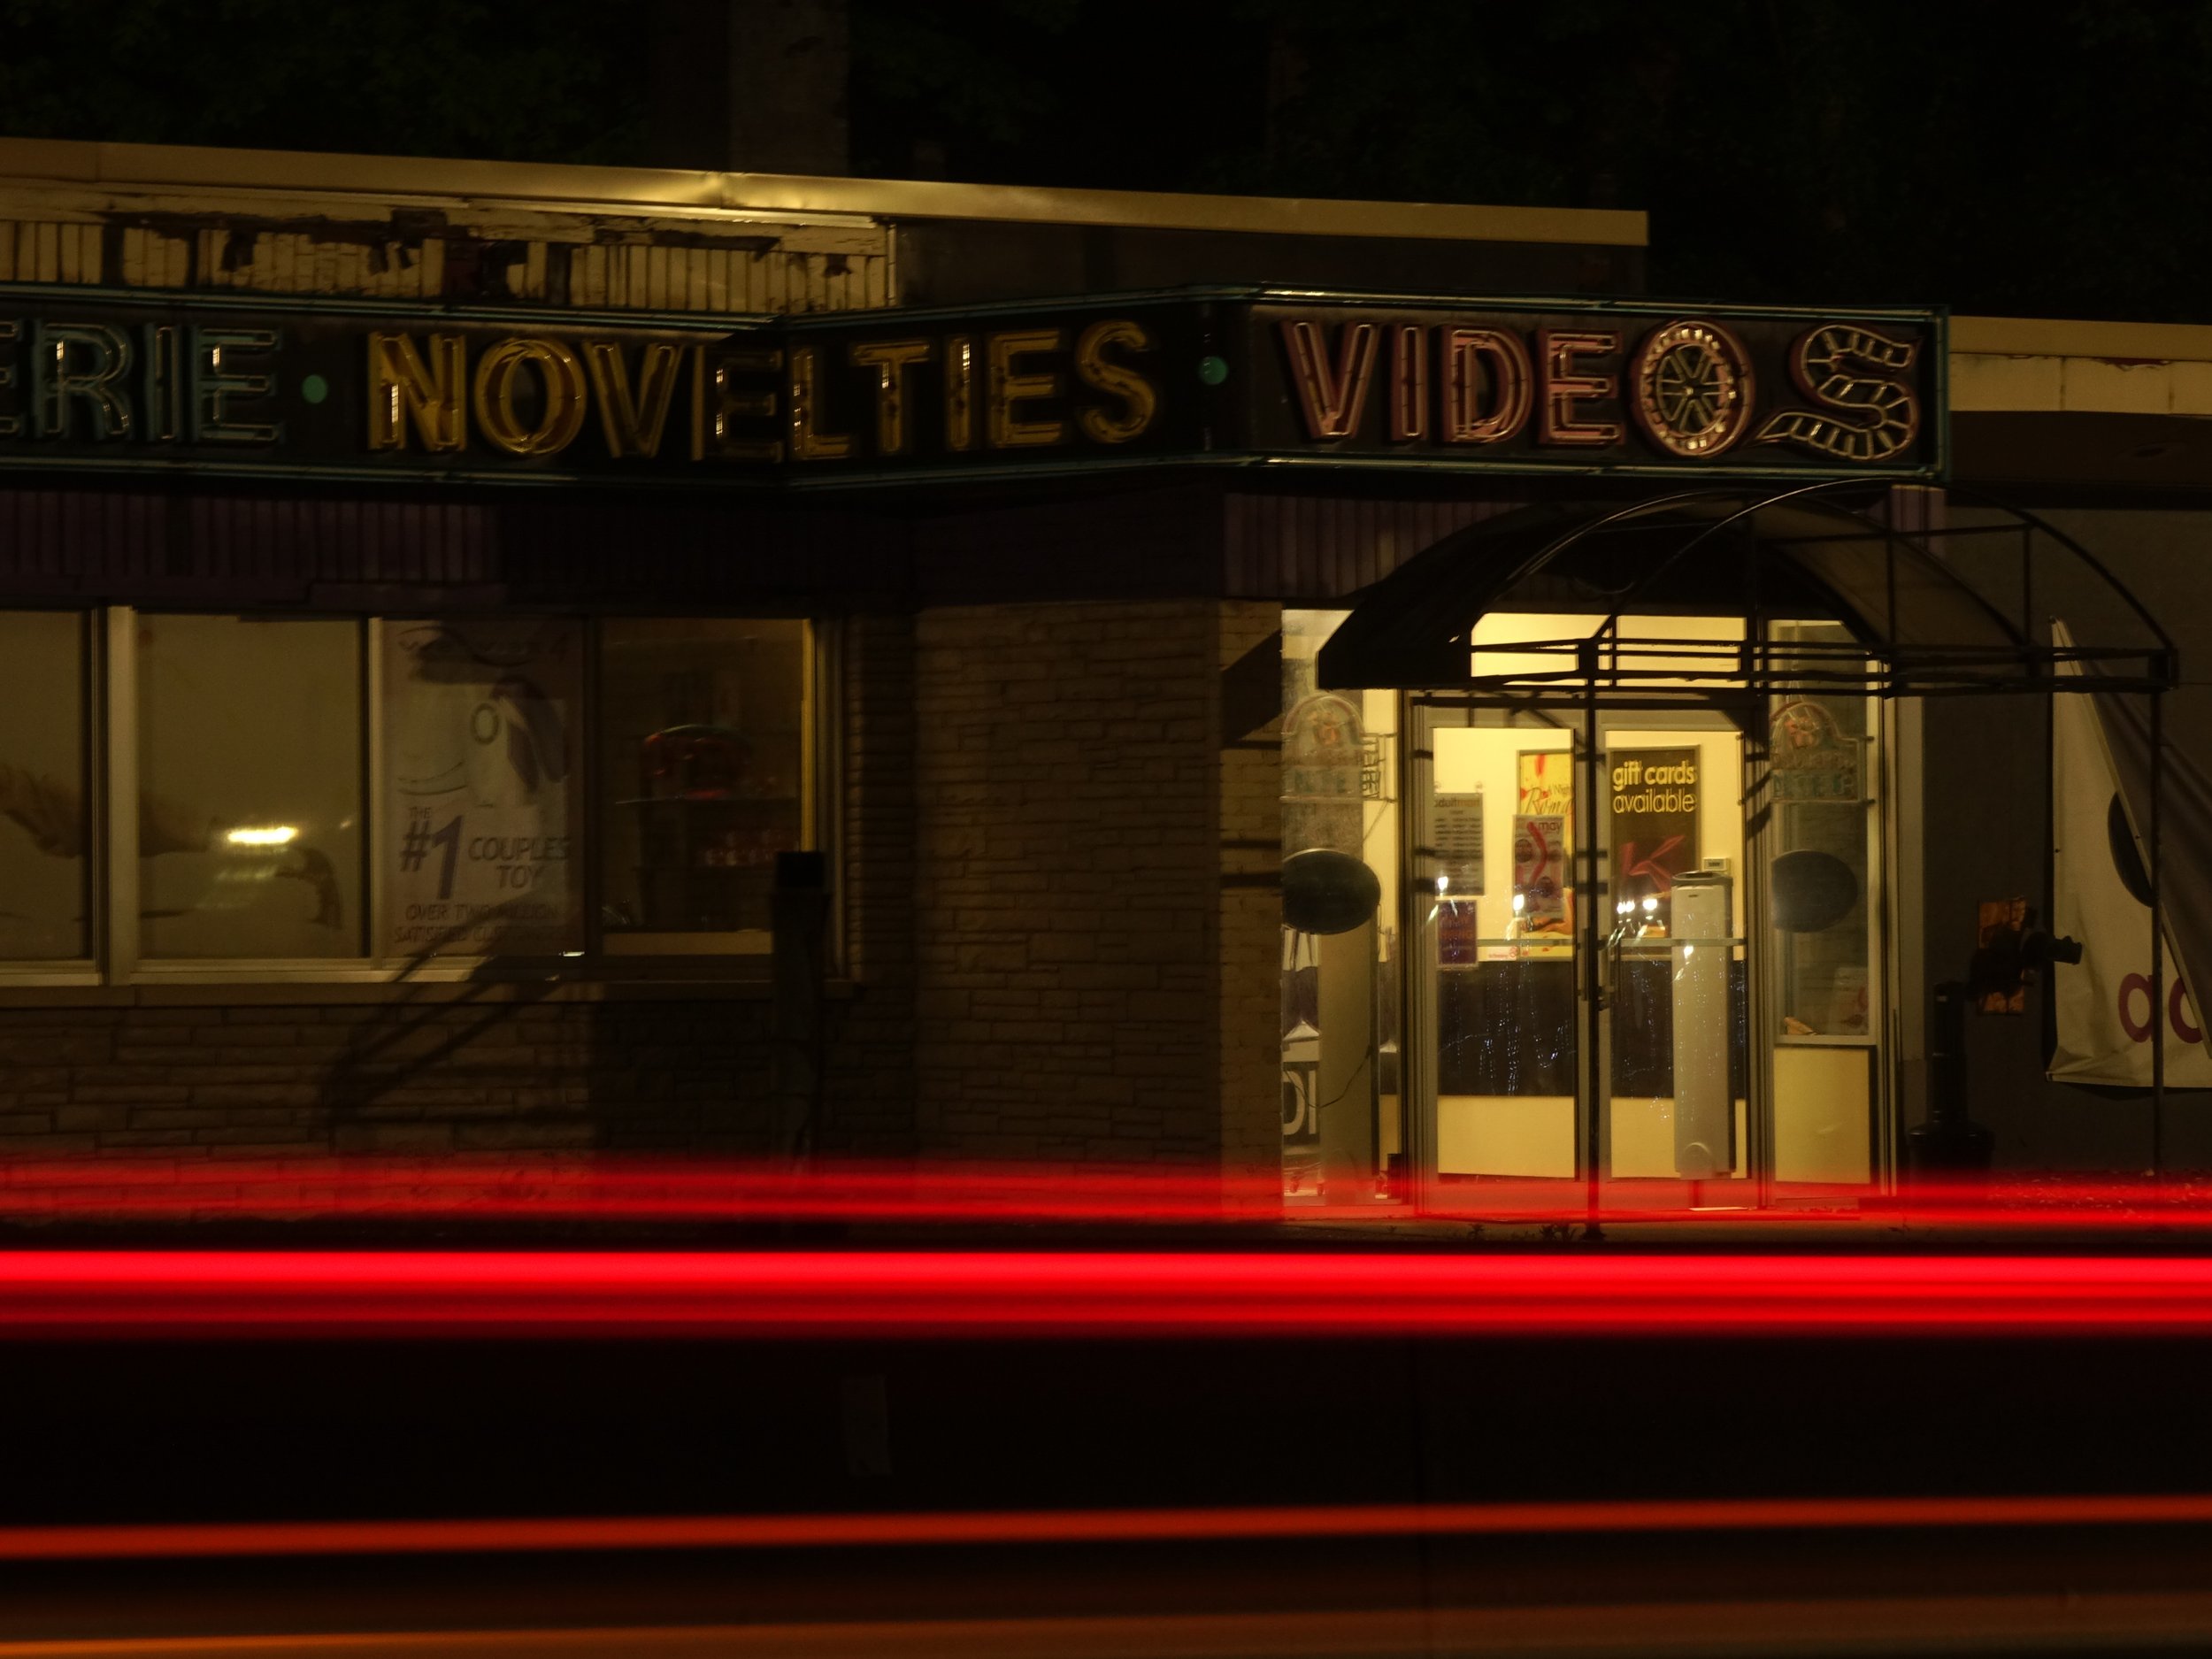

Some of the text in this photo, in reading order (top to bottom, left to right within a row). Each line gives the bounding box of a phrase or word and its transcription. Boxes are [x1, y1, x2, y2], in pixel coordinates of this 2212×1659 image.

[0, 315, 1924, 463] RIE NOVELTIES VIDEOS
[1613, 759, 1697, 791] gift cards
[1613, 787, 1697, 813] available
[399, 815, 465, 900] #1
[468, 836, 572, 861] COUPLES
[495, 864, 546, 889] TOY
[405, 904, 447, 921] OVER
